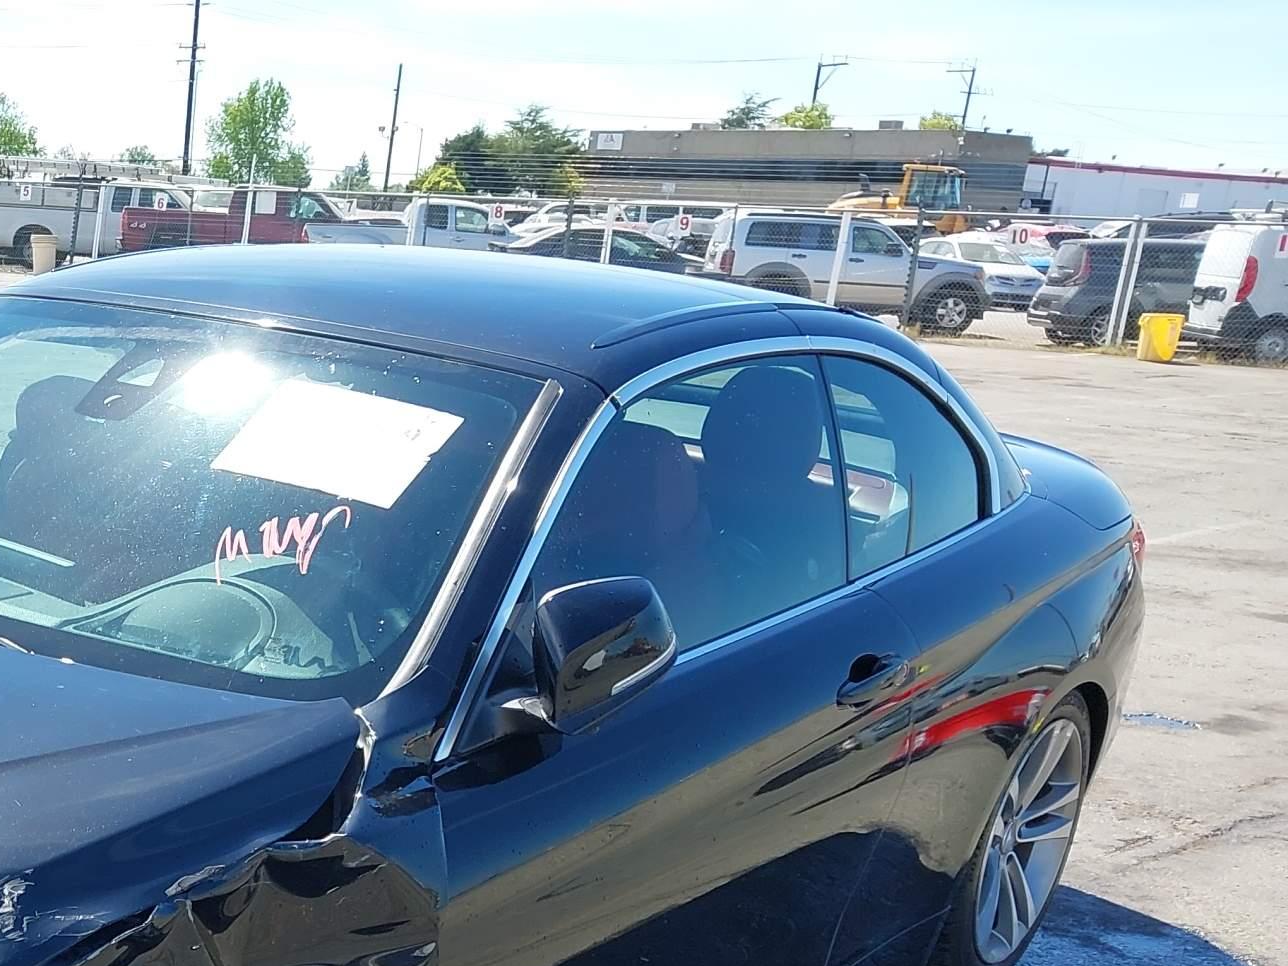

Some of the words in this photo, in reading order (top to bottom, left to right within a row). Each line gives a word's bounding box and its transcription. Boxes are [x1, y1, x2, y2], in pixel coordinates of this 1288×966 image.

[23, 186, 29, 197] 5
[157, 197, 164, 209] 6
[346, 200, 354, 212] 7
[494, 205, 503, 218] 8
[680, 216, 689, 230] 9
[1011, 228, 1028, 244] 10
